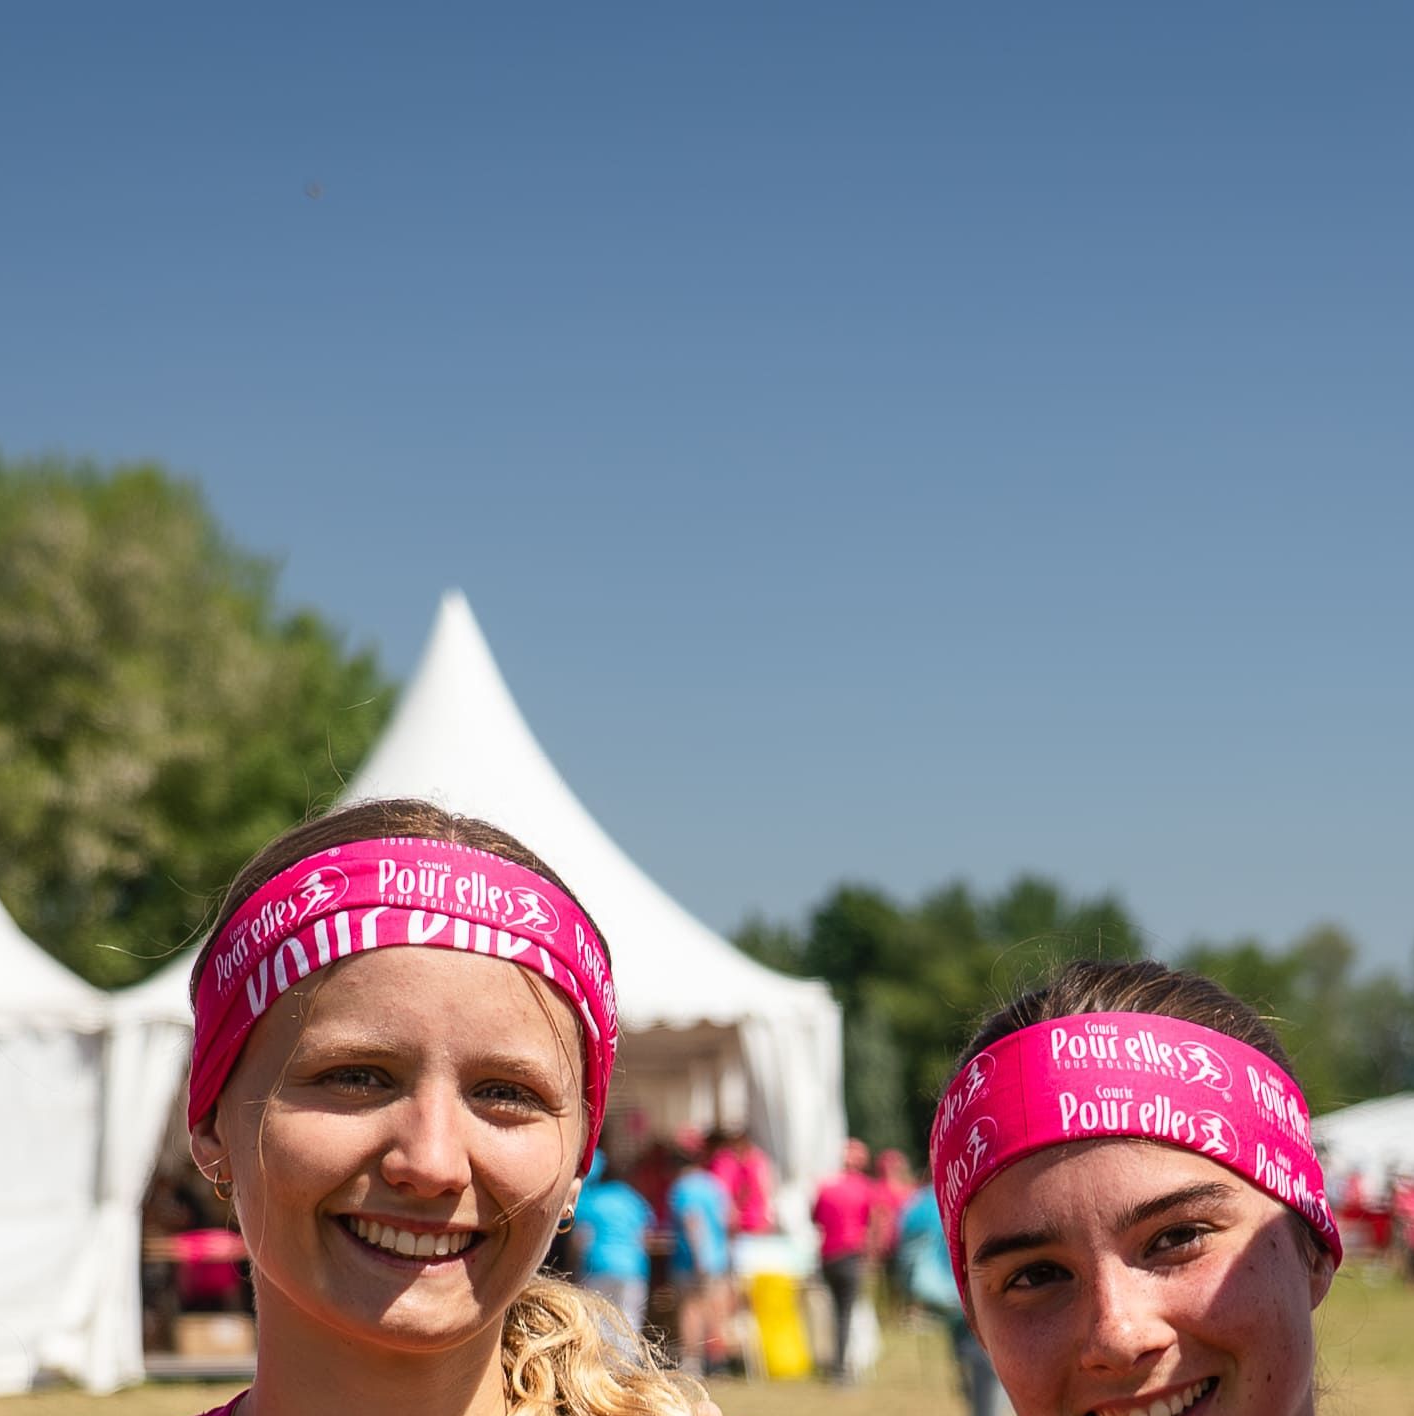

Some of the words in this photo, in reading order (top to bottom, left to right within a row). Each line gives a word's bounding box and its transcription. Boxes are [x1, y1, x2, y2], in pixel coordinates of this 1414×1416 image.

[378, 858, 452, 899] Pour
[455, 871, 515, 916] elles
[380, 894, 413, 905] TOUS
[420, 896, 508, 924] SOLIDAIRES
[214, 933, 251, 993] Pour
[250, 894, 298, 945] elles
[575, 922, 605, 990] Pour
[1051, 1028, 1119, 1061] Pour
[1124, 1031, 1188, 1072] elles
[1084, 1021, 1119, 1035] Courir
[1056, 1059, 1088, 1070] TOUS
[1096, 1061, 1187, 1081] SOLIDAIRES
[1095, 1084, 1134, 1100] Courir
[1247, 1065, 1286, 1124] Pour
[1058, 1092, 1134, 1131] Pour
[1139, 1094, 1195, 1144] elles
[1255, 1143, 1292, 1201] Pour
[1292, 1171, 1321, 1224] elles
